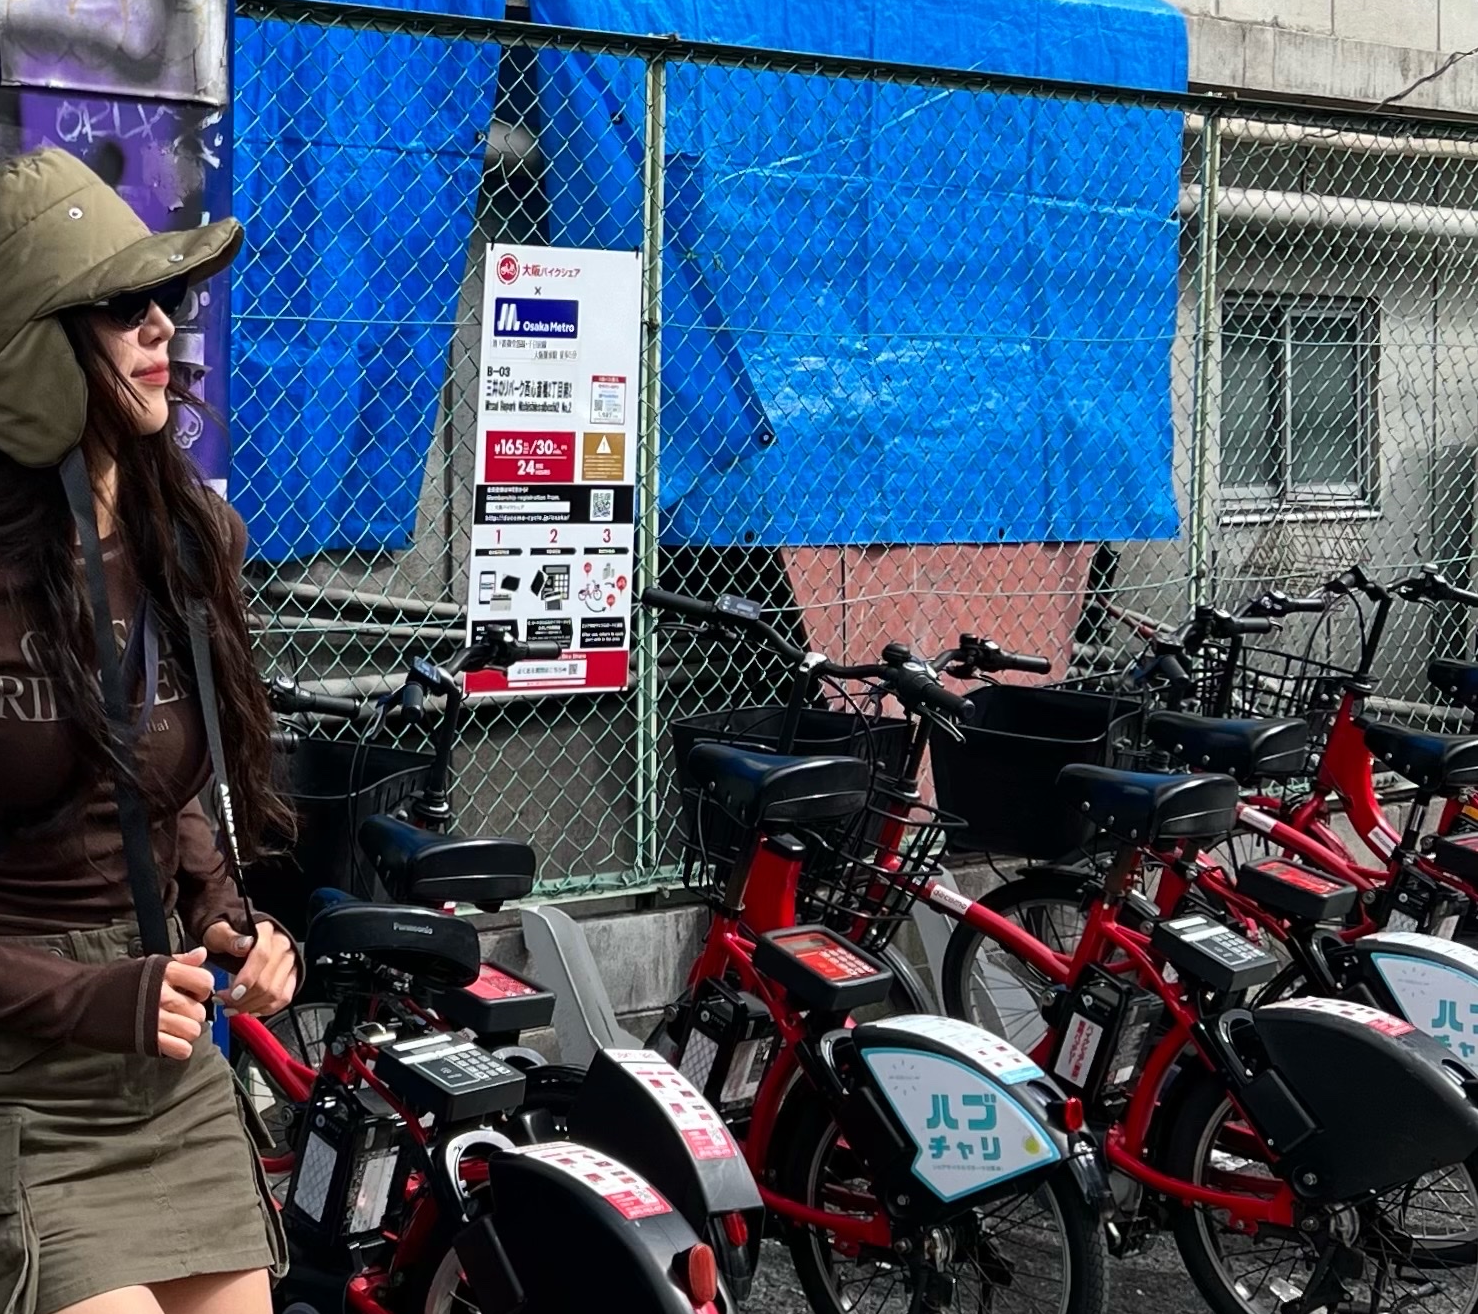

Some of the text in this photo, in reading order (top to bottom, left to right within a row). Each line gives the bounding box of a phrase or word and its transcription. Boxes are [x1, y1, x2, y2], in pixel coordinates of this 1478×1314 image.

[522, 321, 575, 333] Osaka Metro
[487, 366, 511, 377] B-03
[517, 460, 535, 476] 24
[496, 528, 612, 544] 1 2 3
[393, 922, 433, 935] Panasonic
[928, 1136, 1002, 1162] チャリ
